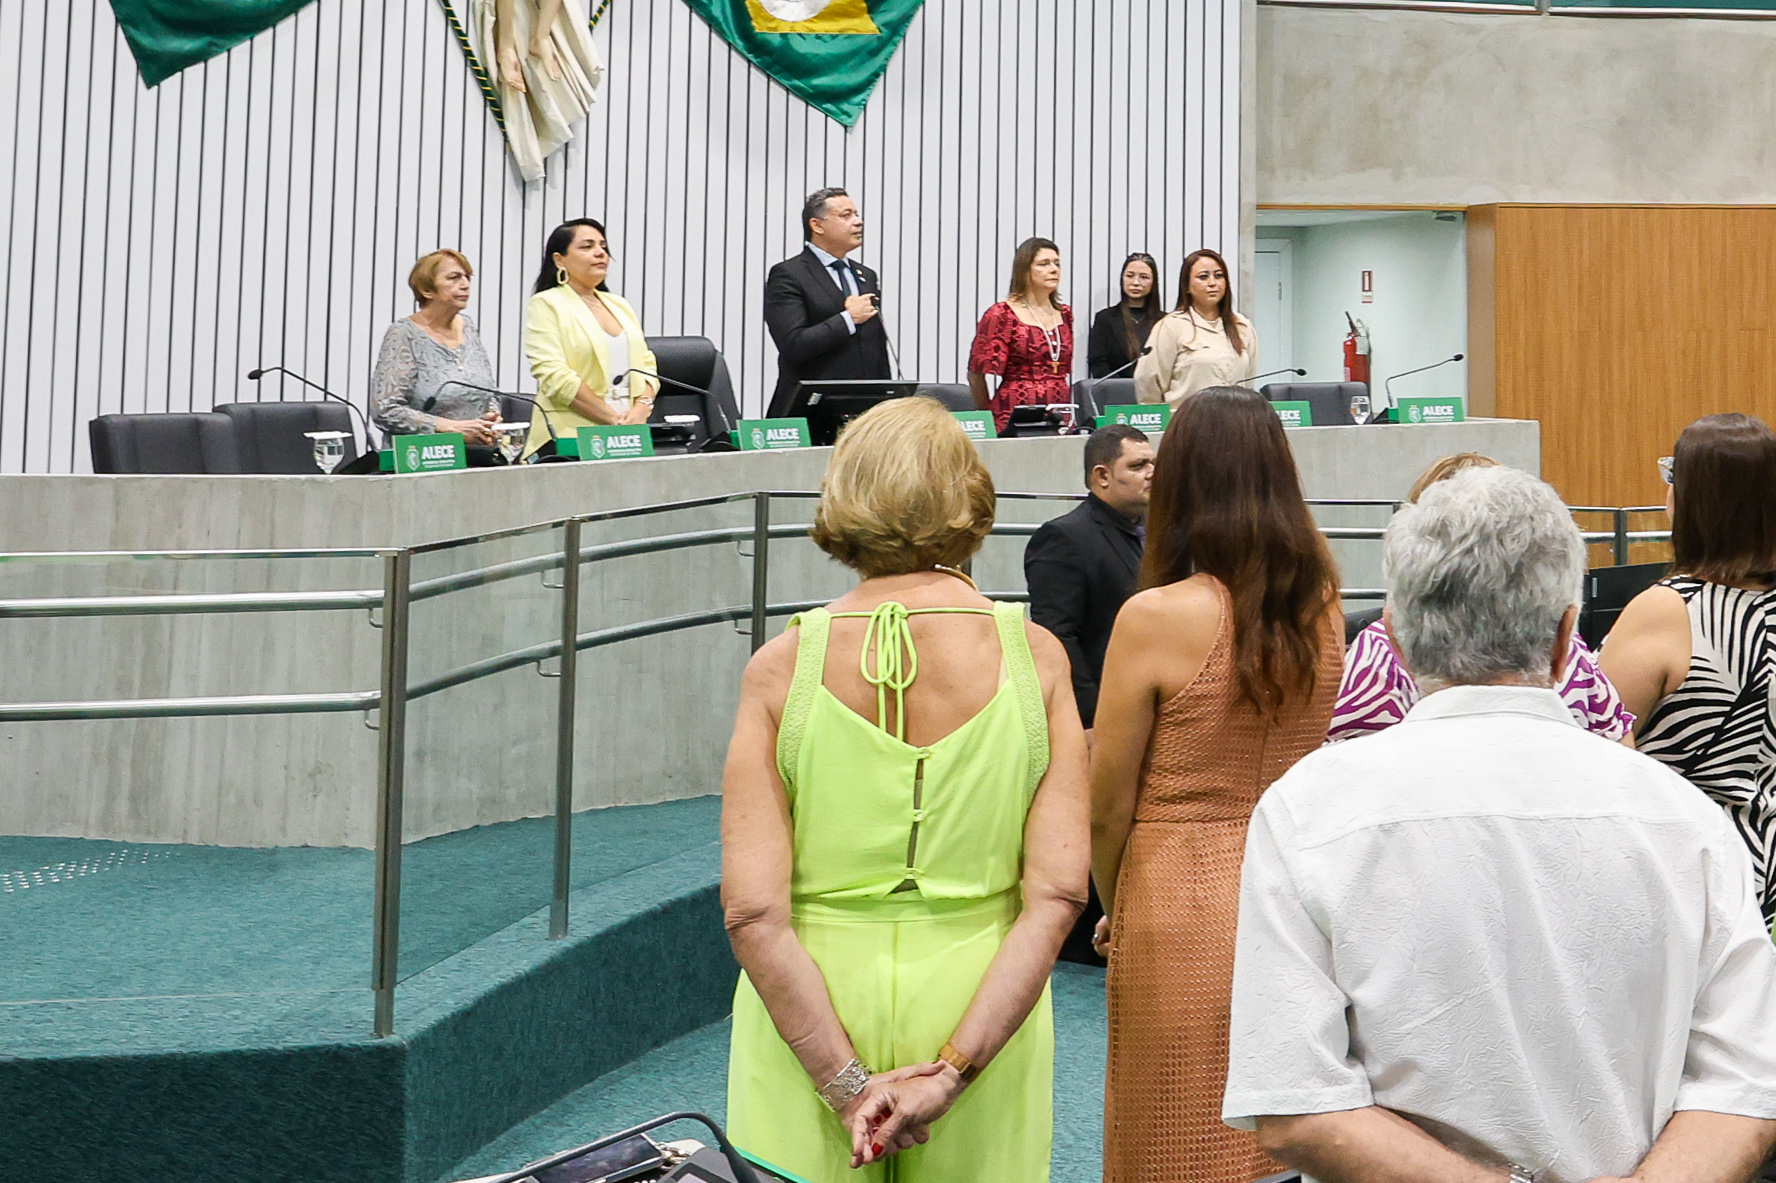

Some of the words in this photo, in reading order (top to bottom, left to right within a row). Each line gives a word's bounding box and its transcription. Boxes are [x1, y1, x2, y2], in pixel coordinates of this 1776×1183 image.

[1422, 405, 1454, 416] ALECE
[1130, 413, 1162, 424] ALECE
[766, 428, 800, 440] ALECE
[606, 435, 642, 448] ALECE
[421, 445, 455, 459] ALECE
